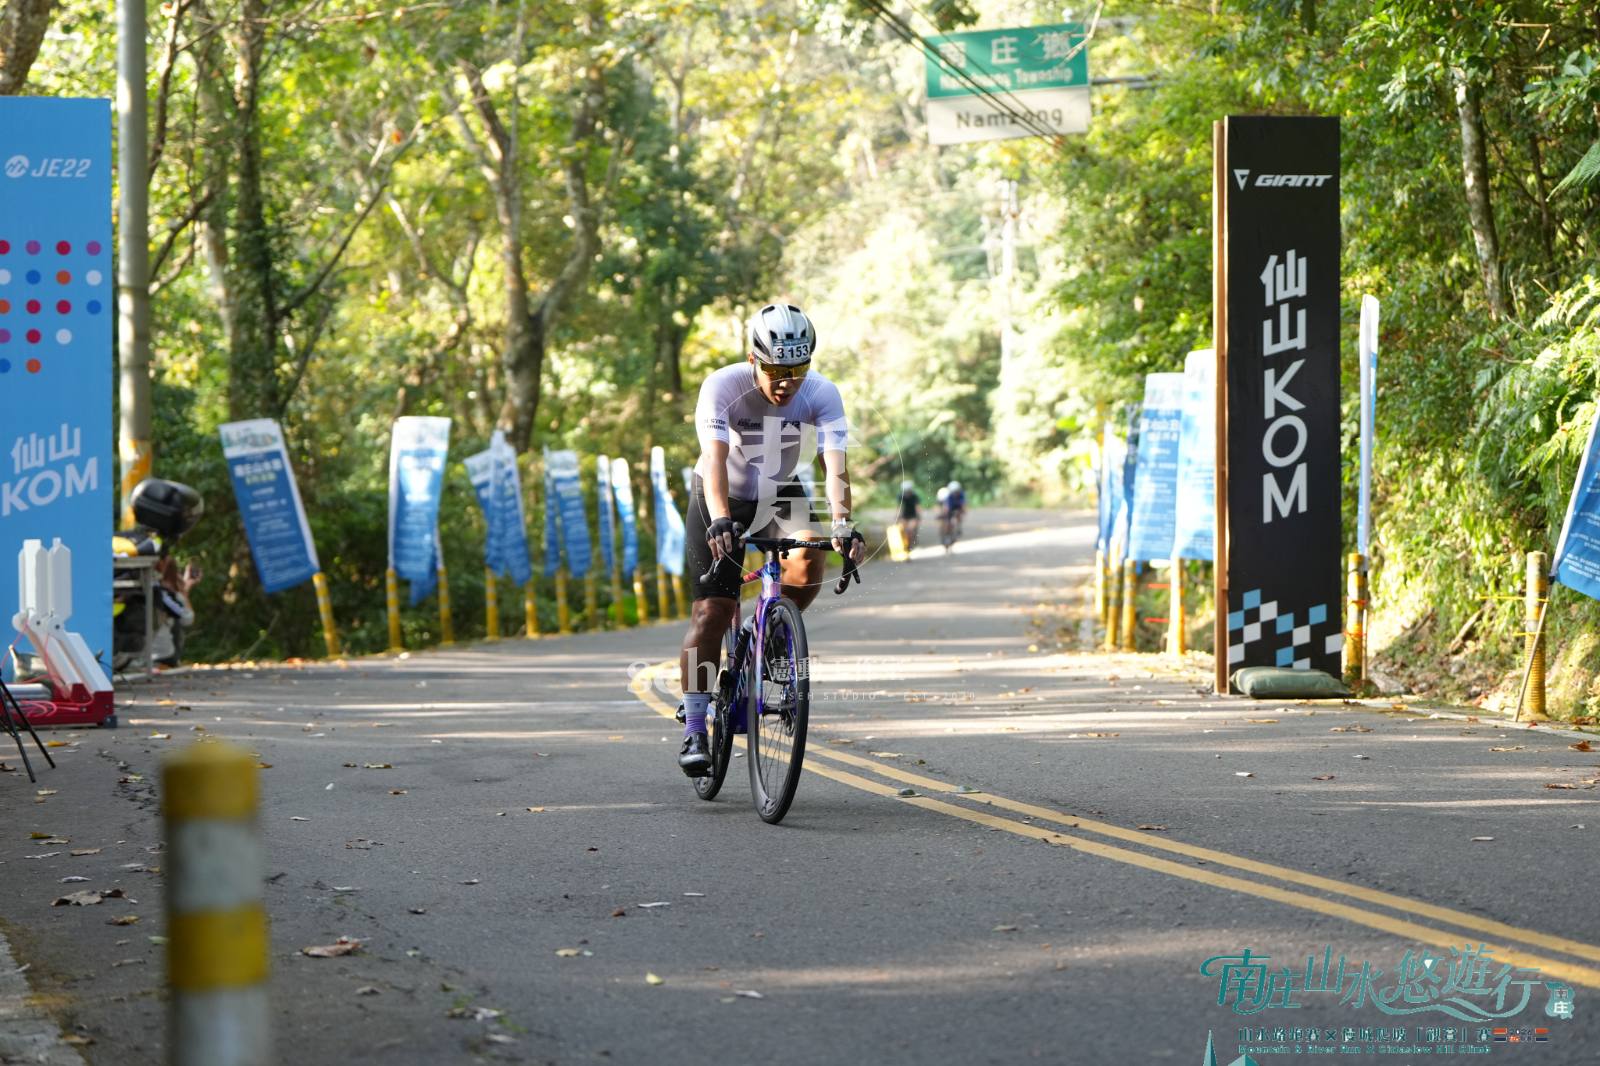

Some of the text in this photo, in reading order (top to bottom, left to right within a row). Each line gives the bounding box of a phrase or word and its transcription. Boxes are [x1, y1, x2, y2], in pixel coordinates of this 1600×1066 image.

[31, 158, 92, 178] JE22
[1254, 174, 1333, 187] GIANT
[10, 423, 81, 475] 仙山
[1, 456, 98, 517] KOM
